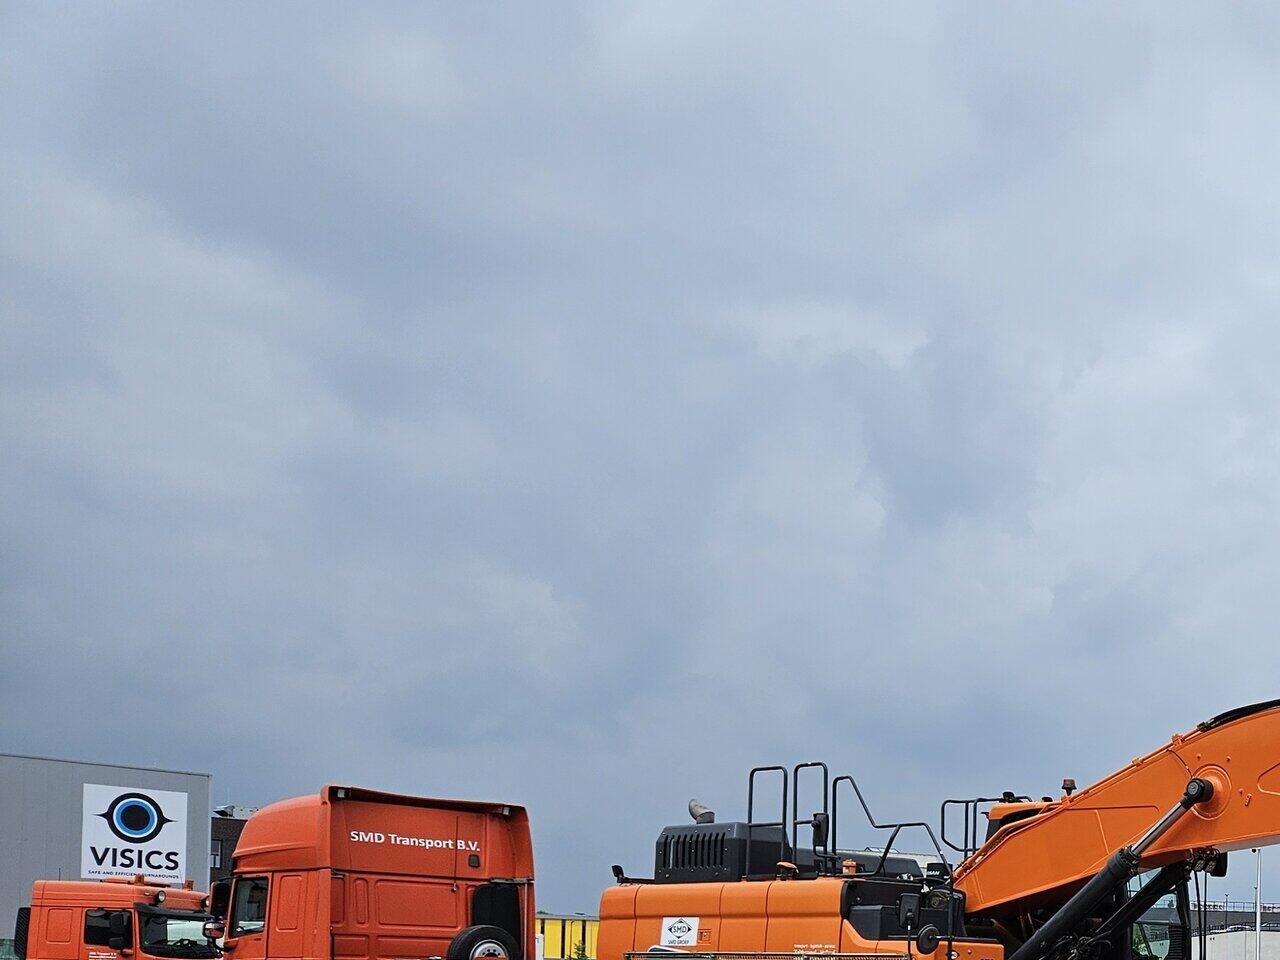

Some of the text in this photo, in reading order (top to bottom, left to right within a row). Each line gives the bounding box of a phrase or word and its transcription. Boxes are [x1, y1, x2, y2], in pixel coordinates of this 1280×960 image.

[350, 831, 480, 851] SMD Transport B.V.
[90, 846, 179, 871] VISICS
[673, 925, 687, 933] SMD
